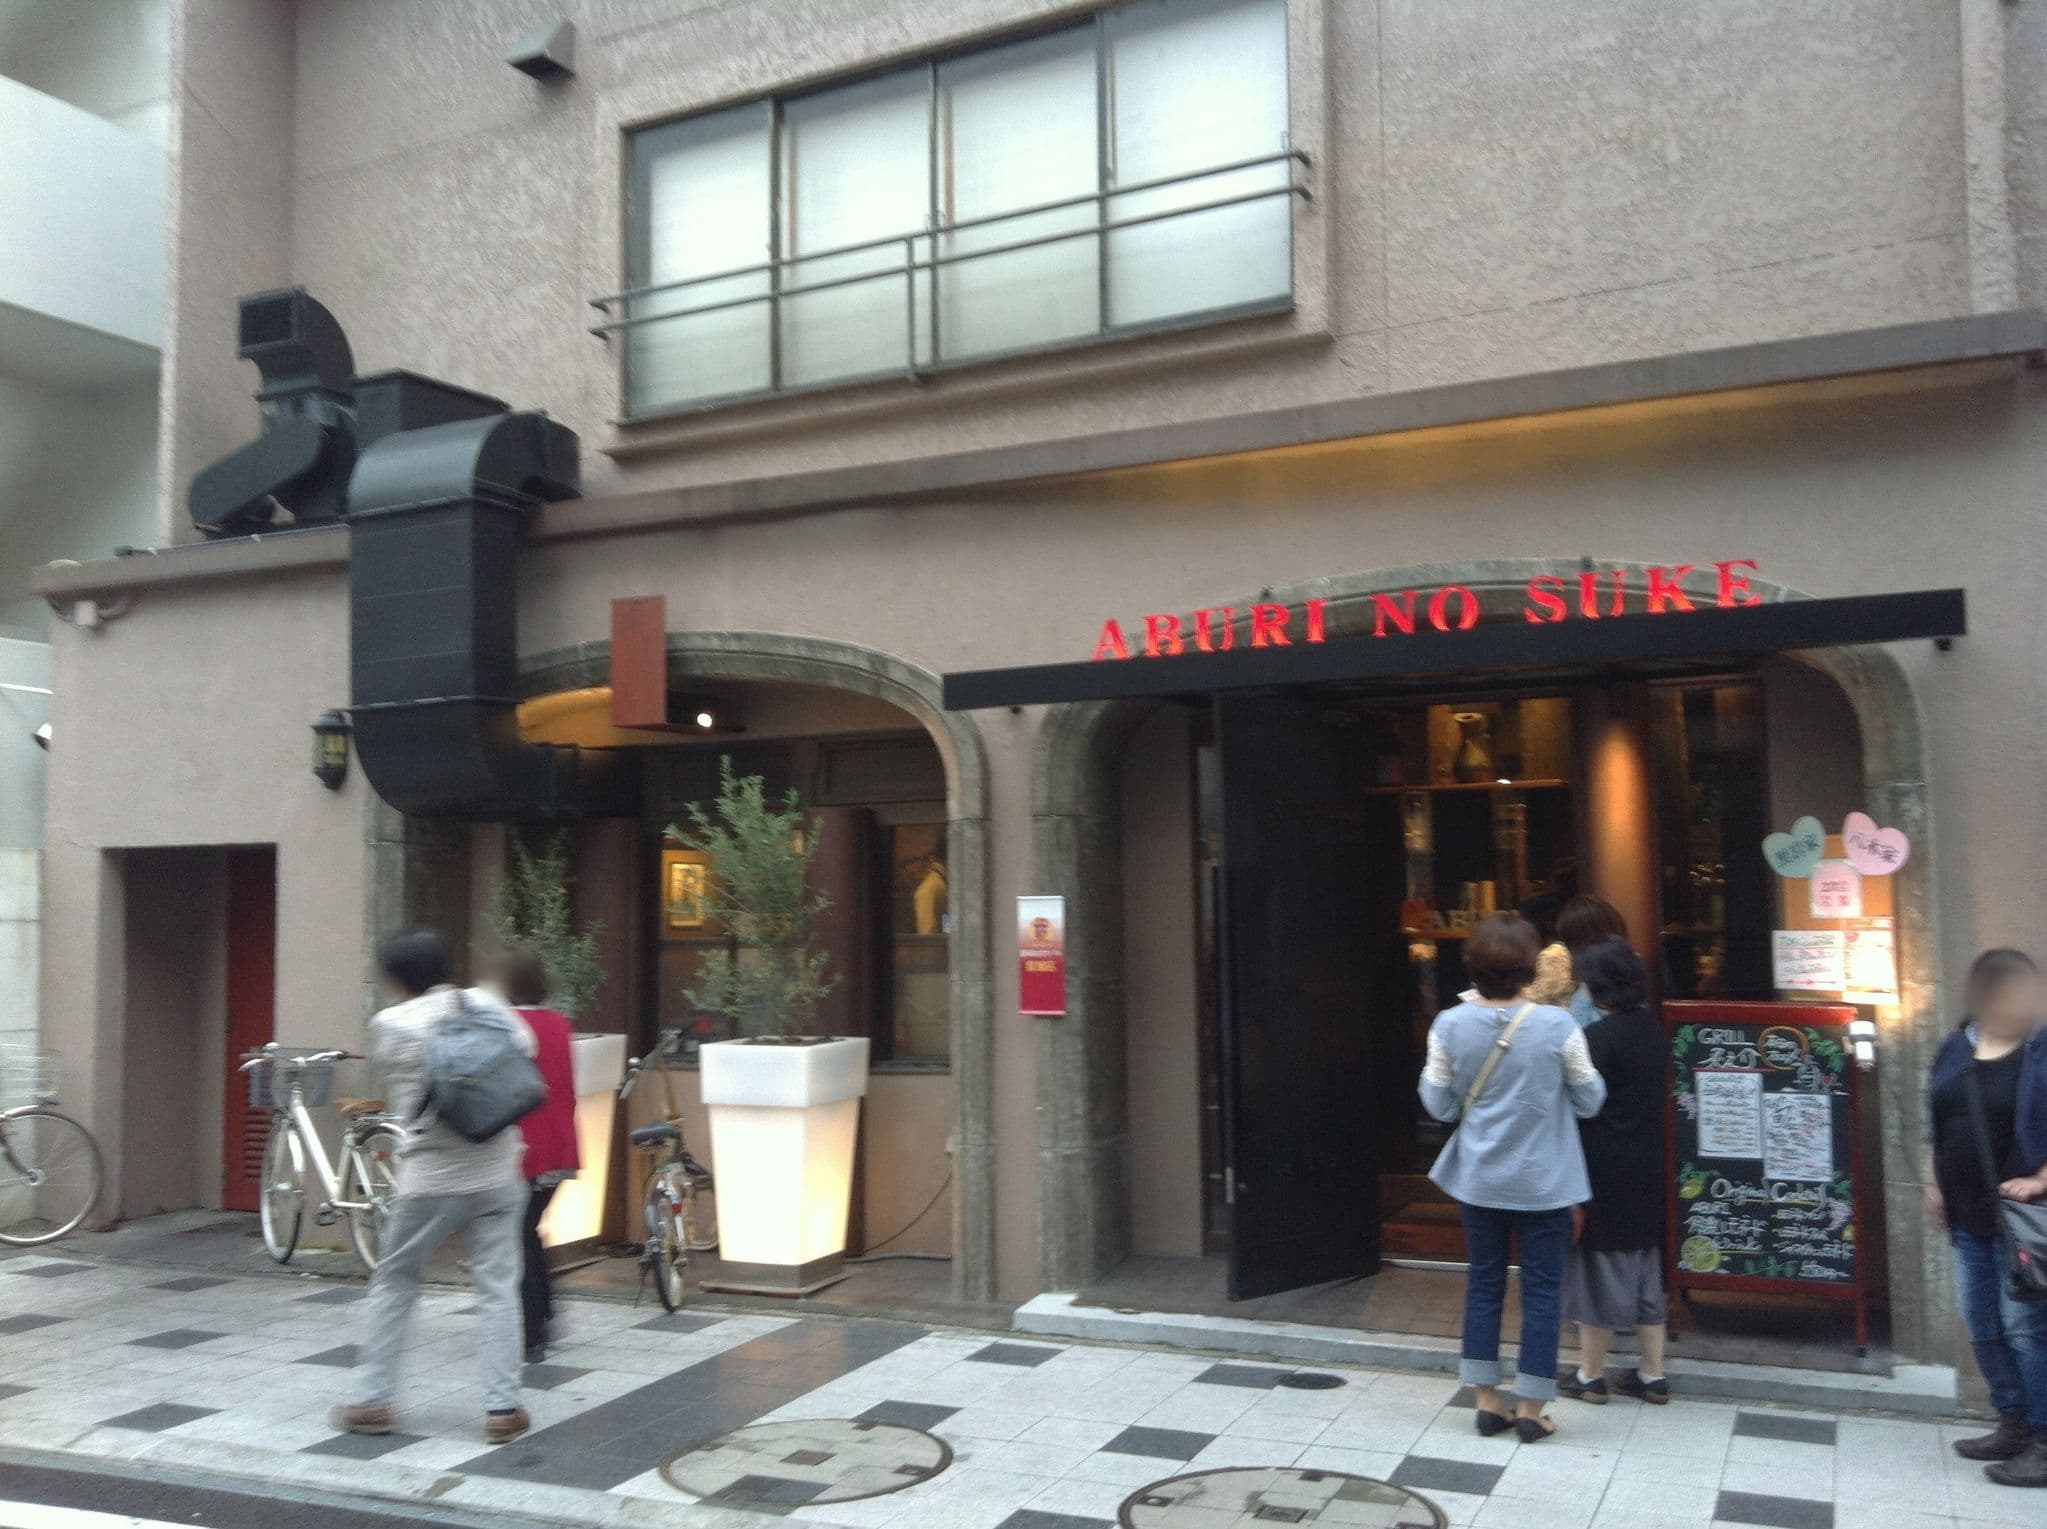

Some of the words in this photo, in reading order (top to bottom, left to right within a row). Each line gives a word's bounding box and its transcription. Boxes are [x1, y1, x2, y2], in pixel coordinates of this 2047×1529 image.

[1093, 599, 1328, 662] ABURI
[1372, 585, 1480, 637] NO
[1524, 559, 1762, 625] SUKE
